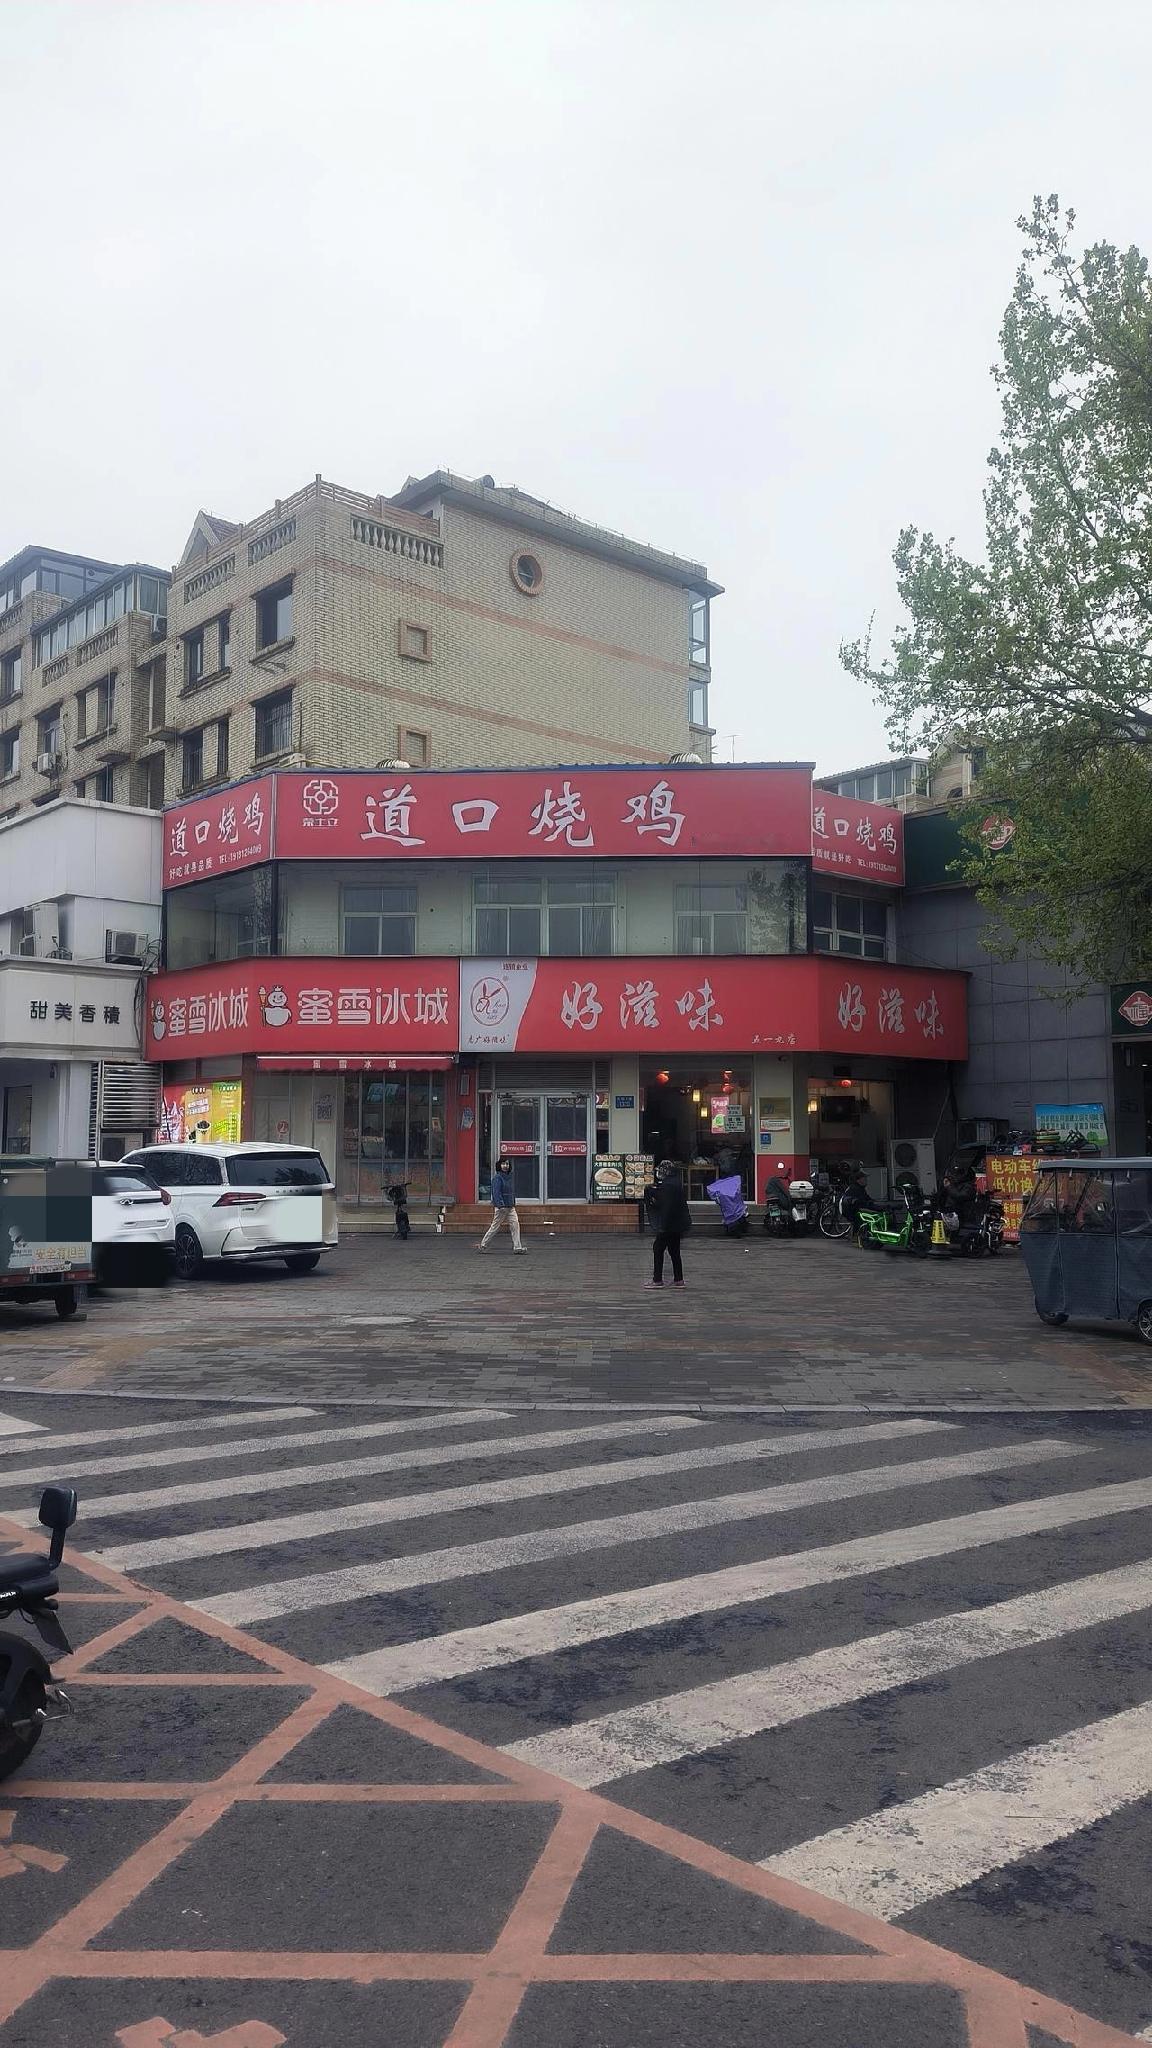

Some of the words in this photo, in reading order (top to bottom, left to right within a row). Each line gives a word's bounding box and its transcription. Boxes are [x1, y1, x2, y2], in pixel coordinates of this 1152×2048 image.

[169, 792, 264, 857] 道口烧鸡
[360, 781, 686, 847] 道口烧鸡
[813, 806, 897, 855] 道口烧鸡
[31, 1001, 120, 1025] 甜美香積
[168, 987, 249, 1038] 蜜雪冰城
[297, 987, 449, 1026] 蜜雪冰城
[560, 978, 724, 1032] 好滋味
[837, 981, 945, 1041] 好滋味
